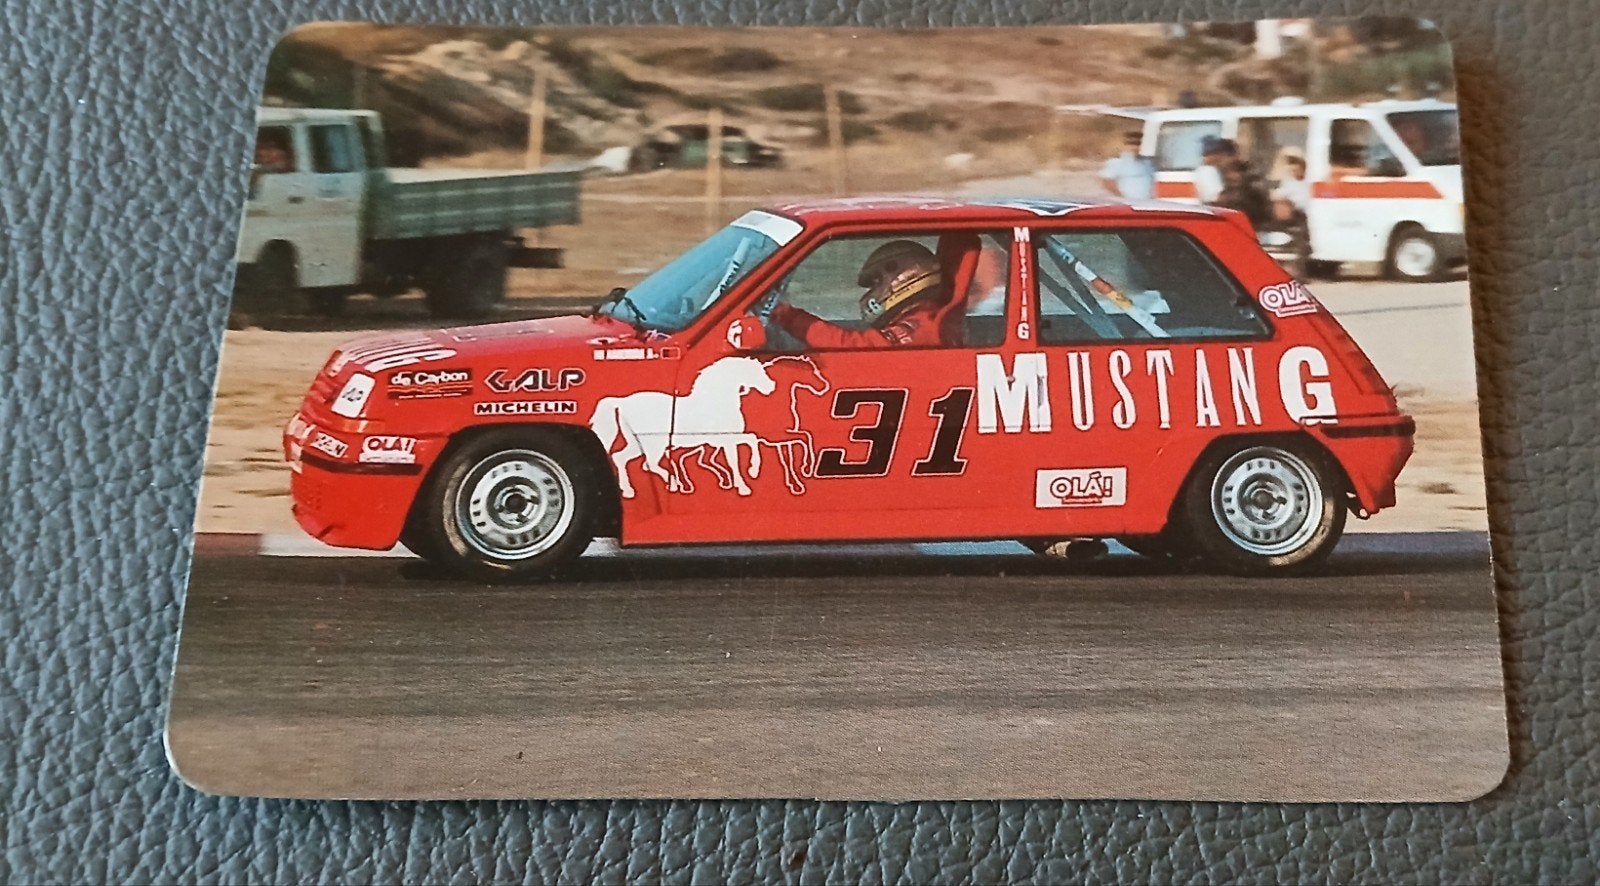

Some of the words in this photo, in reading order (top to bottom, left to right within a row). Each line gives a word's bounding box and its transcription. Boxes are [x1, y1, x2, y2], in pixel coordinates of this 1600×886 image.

[414, 371, 468, 385] Carbon
[484, 367, 586, 393] GALP
[976, 346, 1338, 433] MUSTANG
[476, 402, 575, 413] MICHELIN
[814, 387, 975, 478] 31
[1050, 471, 1113, 499] OLÁ!
